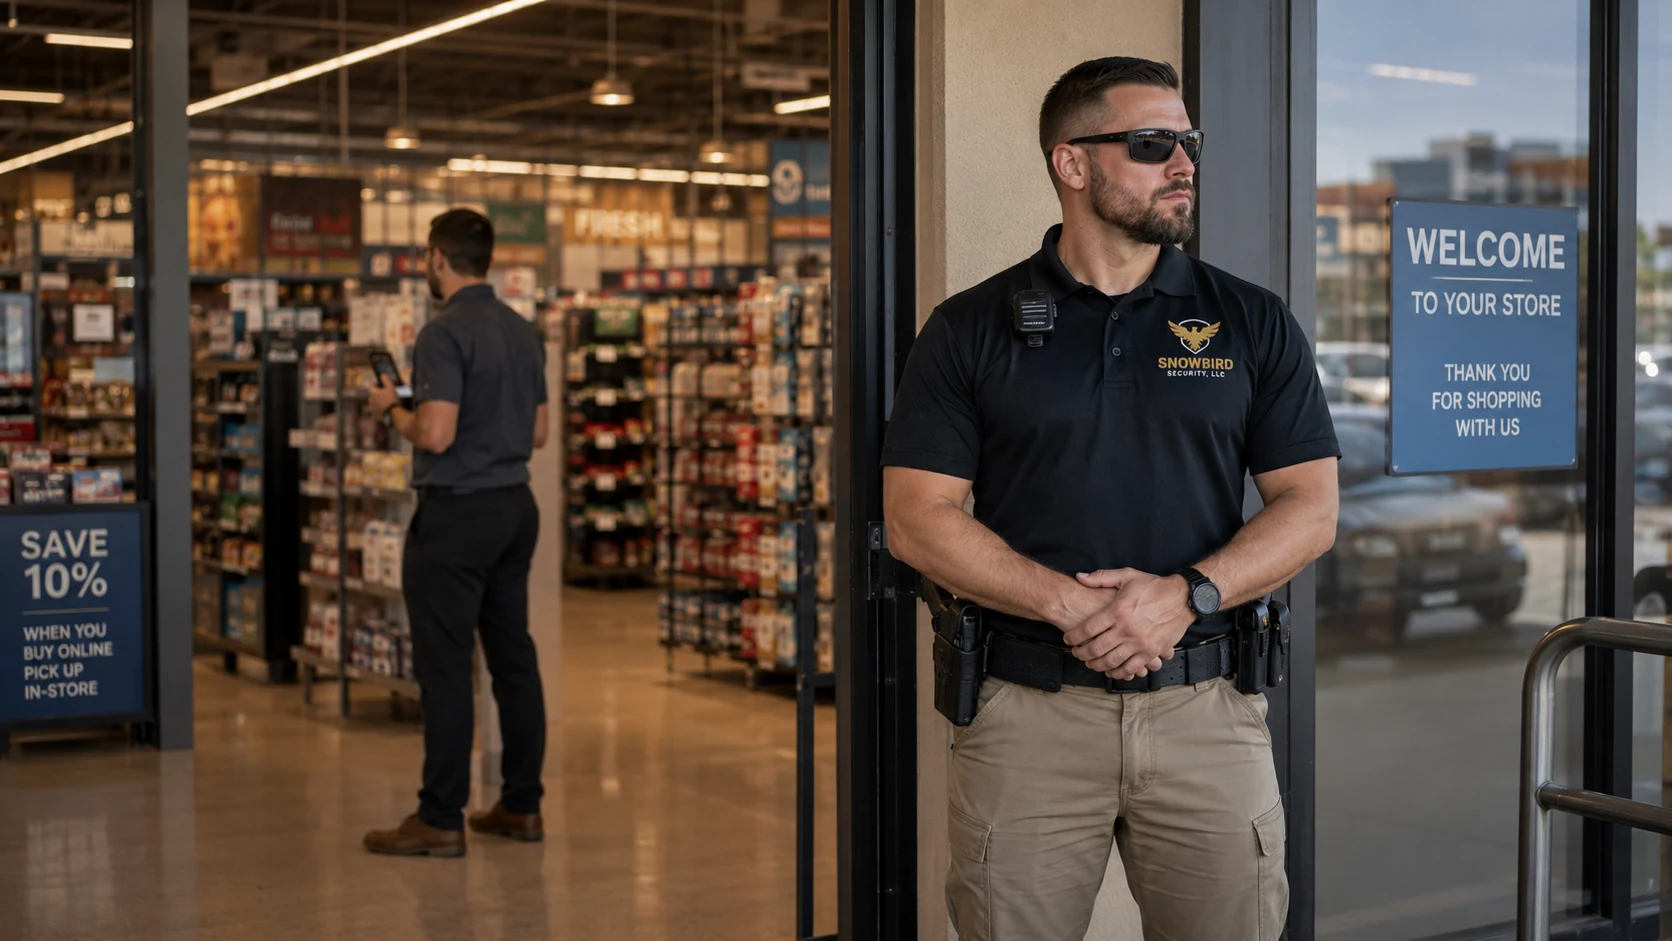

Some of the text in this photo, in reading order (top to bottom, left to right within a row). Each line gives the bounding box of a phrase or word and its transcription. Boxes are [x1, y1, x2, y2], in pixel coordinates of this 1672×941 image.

[574, 208, 663, 239] FRESH
[1406, 227, 1566, 269] WELCOME
[1411, 291, 1561, 317] TO YOUR STORE
[1158, 357, 1234, 370] SNOWBIRD
[1444, 363, 1531, 382] THANK YOU
[1167, 370, 1209, 378] SECURITY,
[1432, 390, 1541, 410] FOR SHOPPING
[1455, 417, 1520, 437] WITH US
[21, 528, 108, 560] SAVE
[24, 561, 108, 600] 10%
[23, 622, 107, 641] WHEN YOU
[23, 641, 114, 661] BUY ONLINE
[24, 662, 84, 680] PICK UP
[24, 680, 99, 700] IN-STORE
